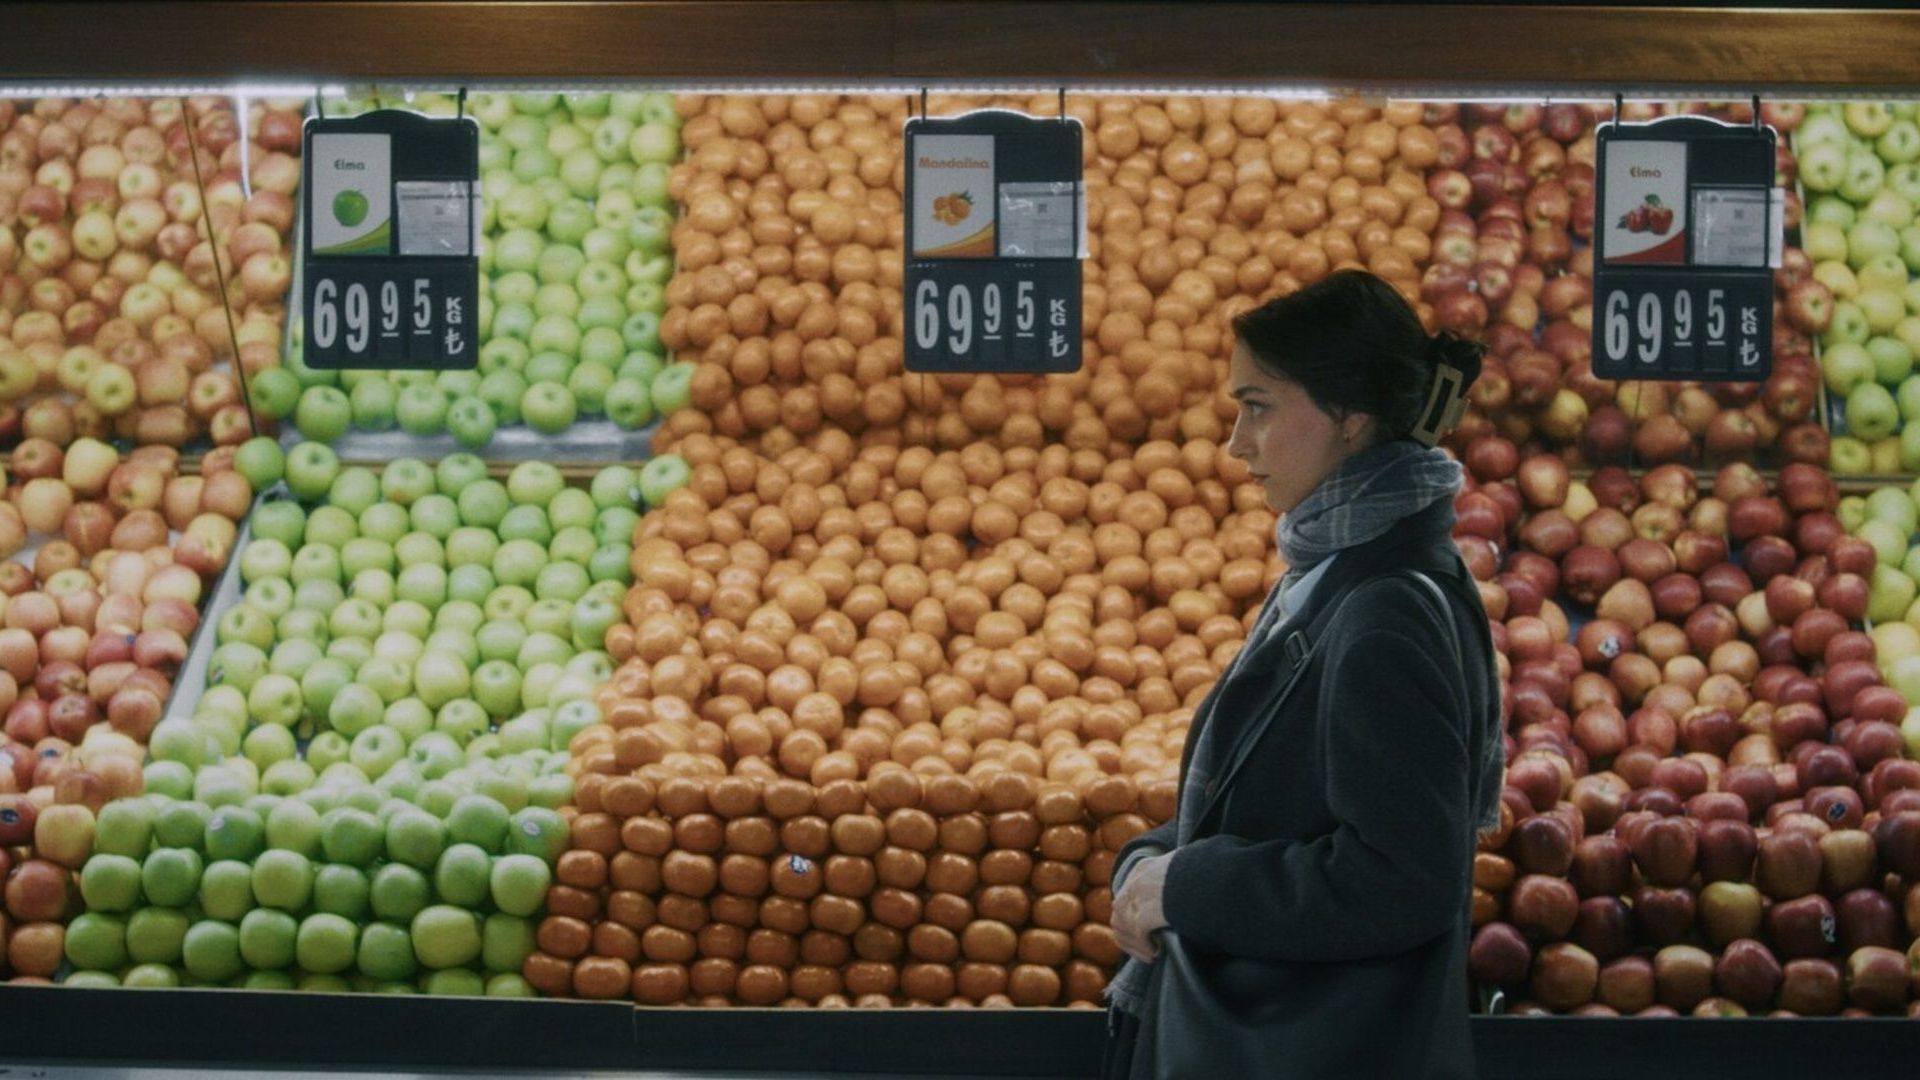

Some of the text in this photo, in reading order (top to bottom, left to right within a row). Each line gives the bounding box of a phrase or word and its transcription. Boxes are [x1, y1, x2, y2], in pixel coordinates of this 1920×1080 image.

[333, 158, 366, 171] Elma
[918, 157, 990, 170] Mandalina
[1629, 165, 1662, 178] Elma
[313, 278, 369, 353] 69
[914, 279, 972, 355] 69
[1605, 289, 1662, 363] 69
